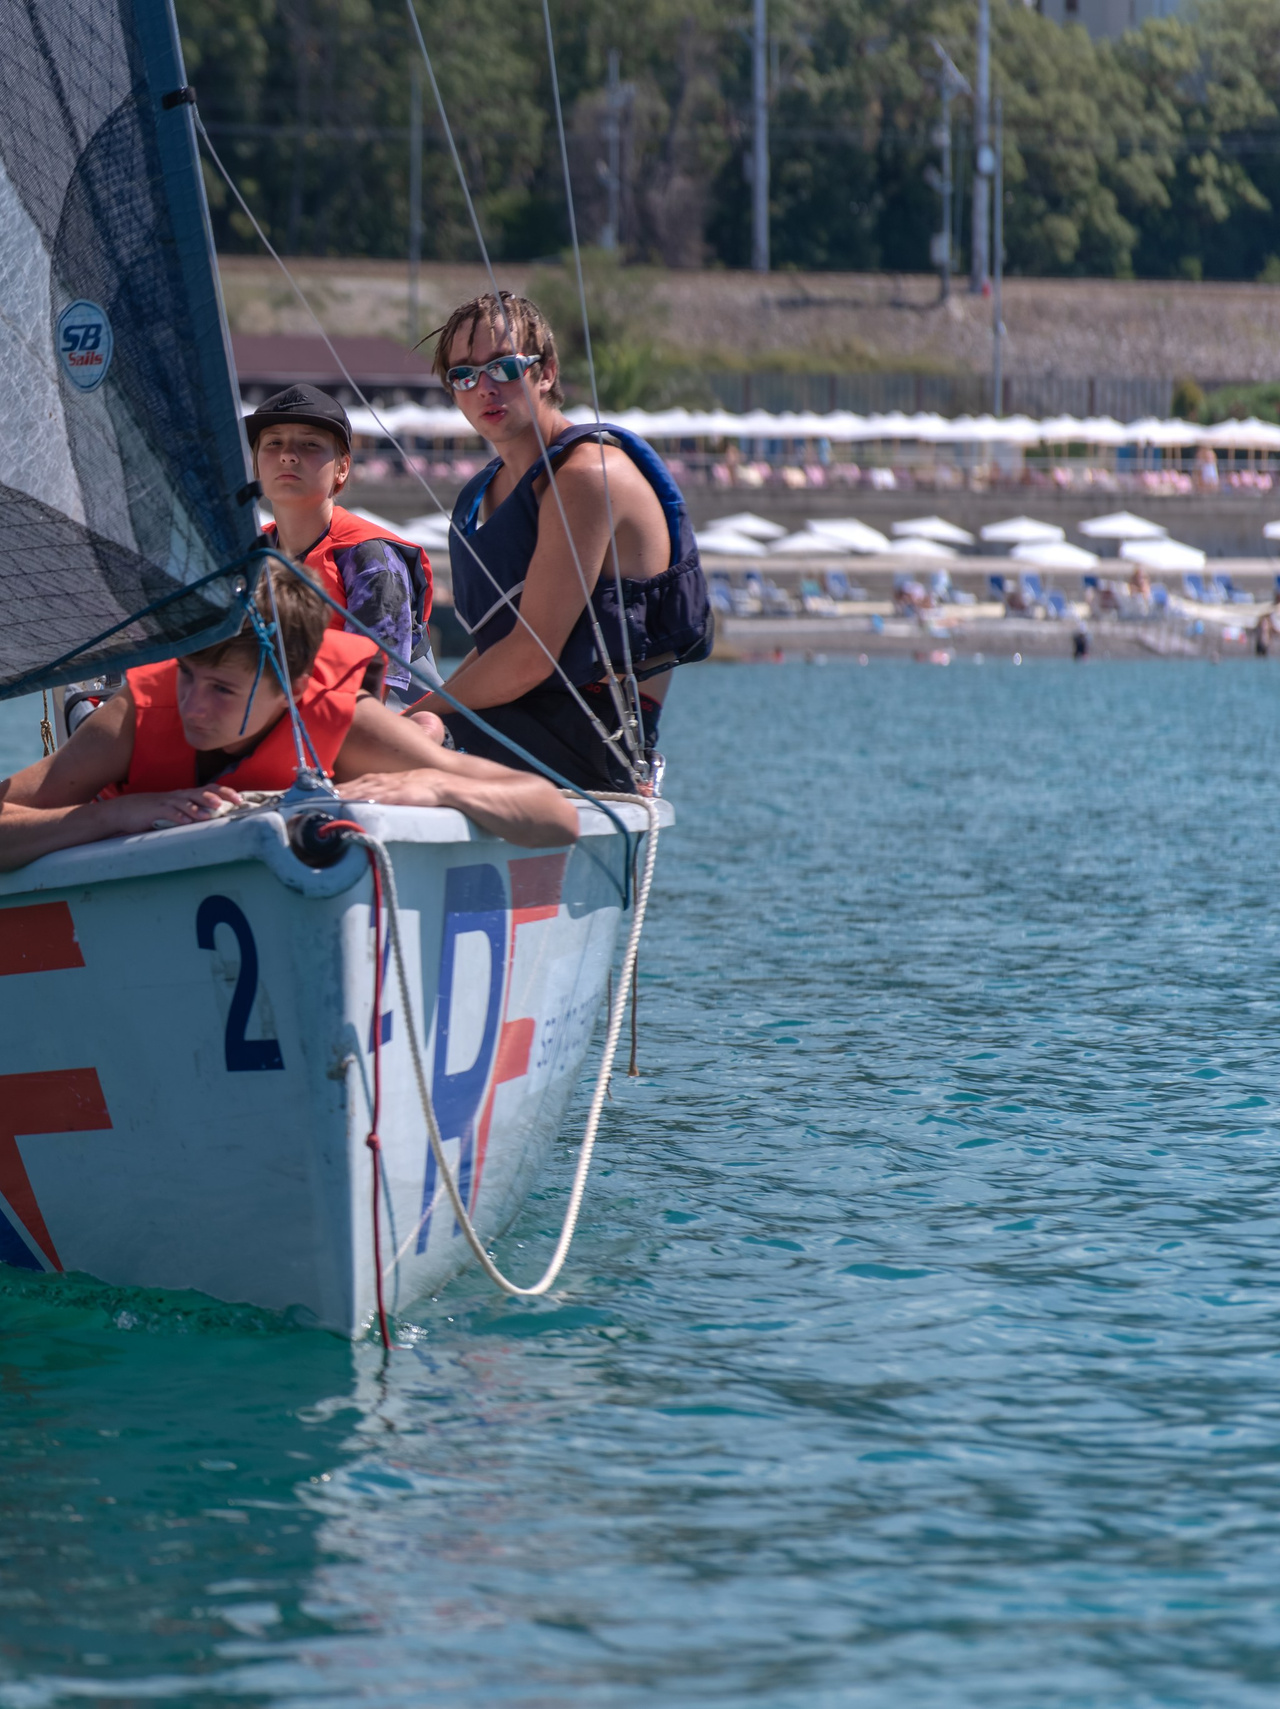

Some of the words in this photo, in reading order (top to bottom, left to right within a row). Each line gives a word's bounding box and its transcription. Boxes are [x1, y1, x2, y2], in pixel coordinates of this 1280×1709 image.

[61, 324, 102, 352] SB
[68, 351, 104, 367] Sails
[196, 895, 285, 1072] 2
